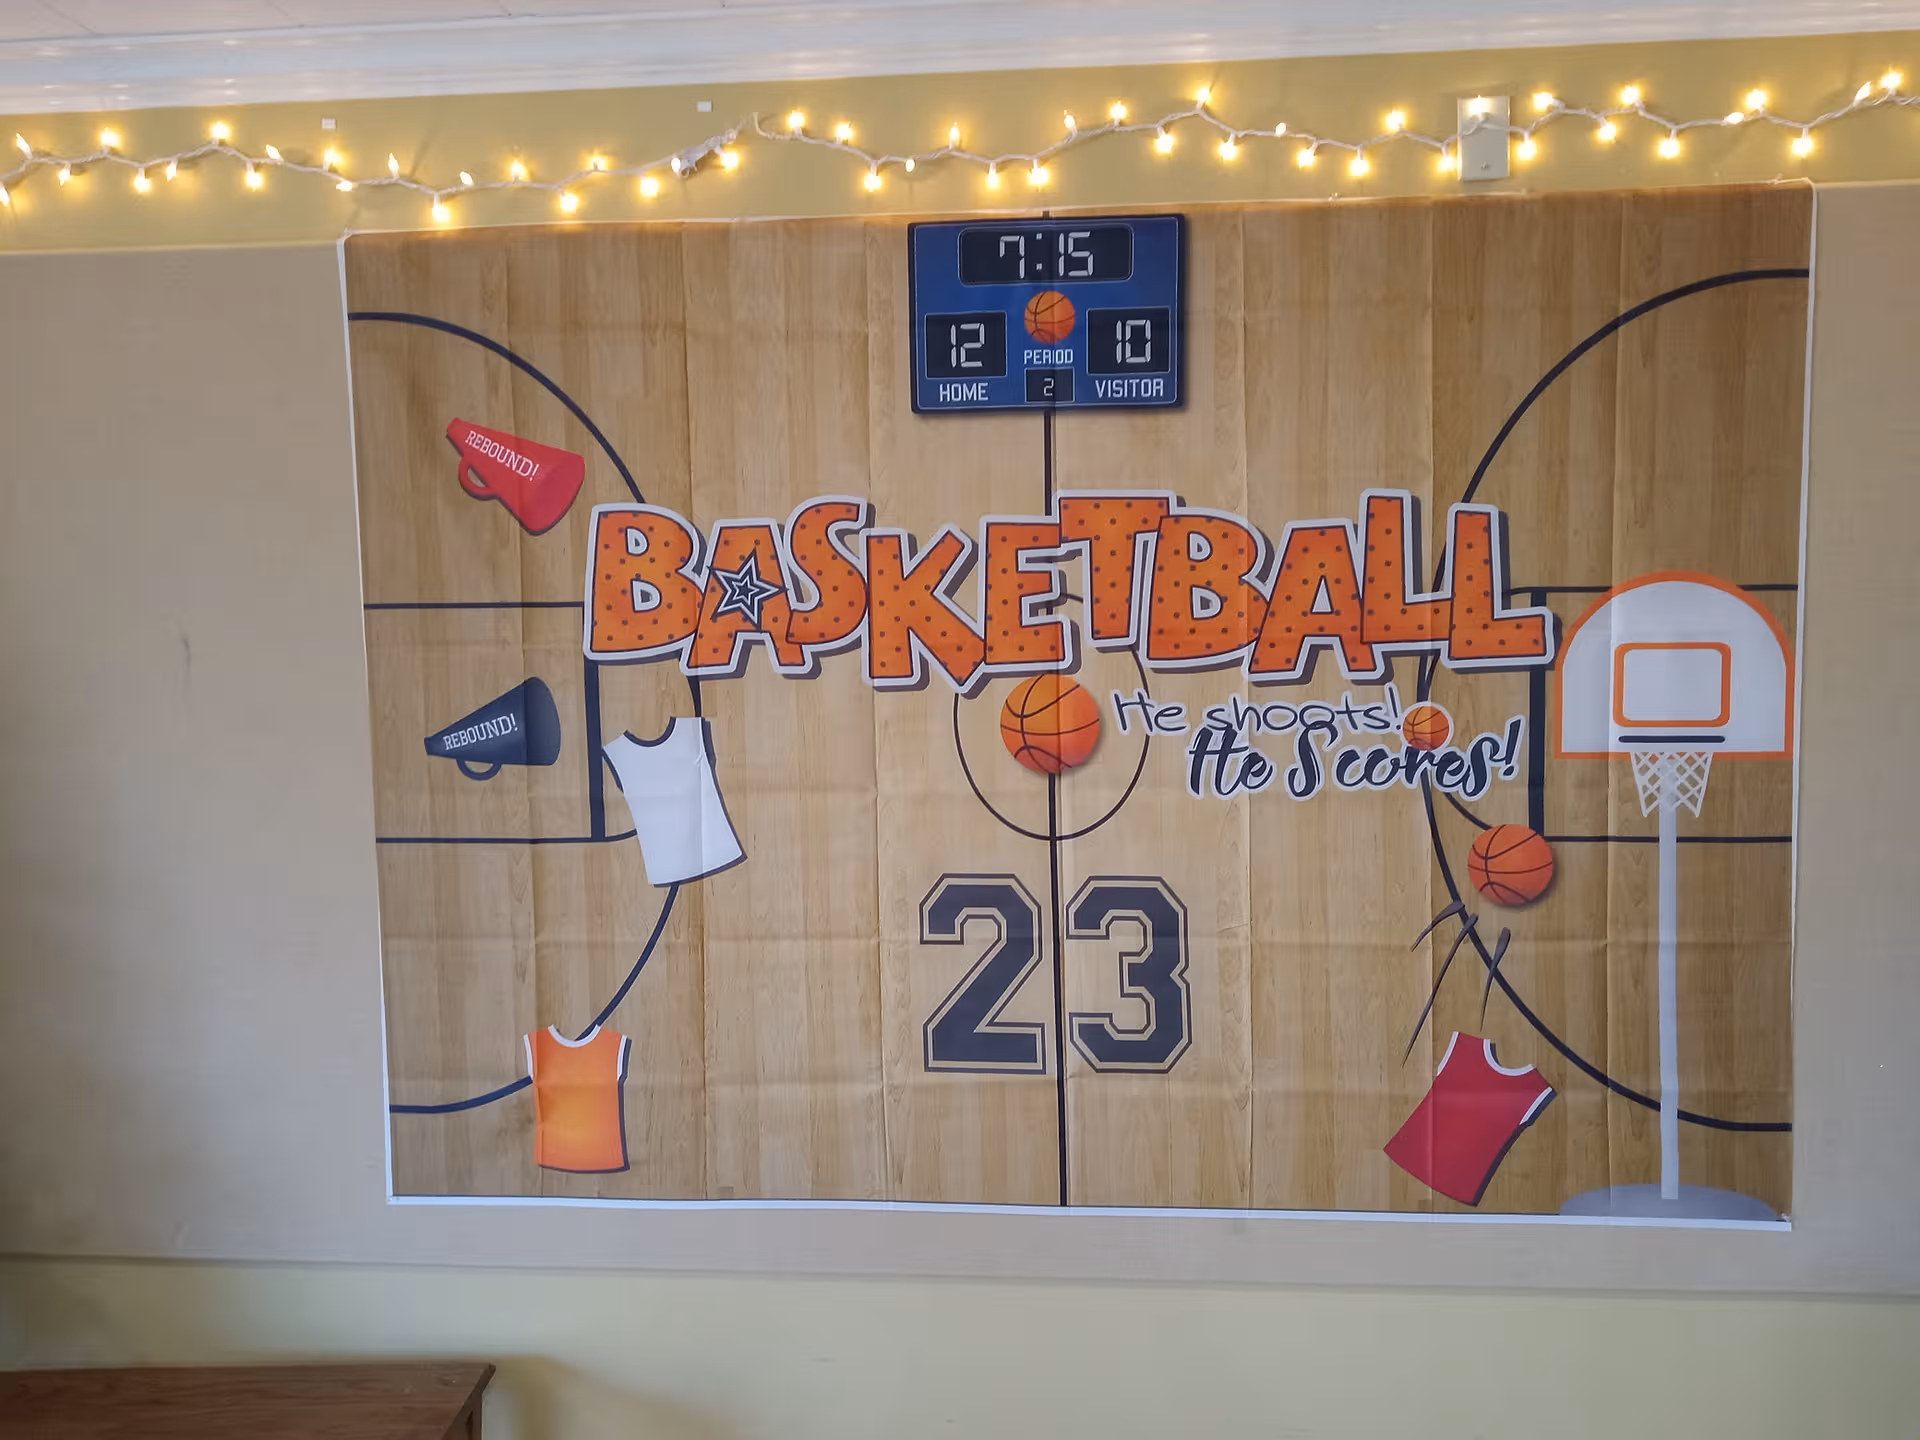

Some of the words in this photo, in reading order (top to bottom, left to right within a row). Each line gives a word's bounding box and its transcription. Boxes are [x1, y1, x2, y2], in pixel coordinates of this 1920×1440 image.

[999, 231, 1094, 279] 7:15
[950, 323, 985, 369] 12
[1023, 348, 1074, 365] PERIOD
[1116, 319, 1152, 364] 10
[939, 382, 989, 402] HOME
[1043, 378, 1055, 397] 2
[1094, 378, 1164, 399] VISITOR
[464, 430, 539, 481] REBOUND!
[586, 491, 1553, 694] BASKETBALL
[1112, 692, 1188, 733] He
[1206, 683, 1402, 732] shoots!
[443, 713, 518, 751] REBOUND!
[1188, 727, 1275, 796] He
[1287, 719, 1522, 799] Scores!
[918, 873, 1193, 1075] 23
